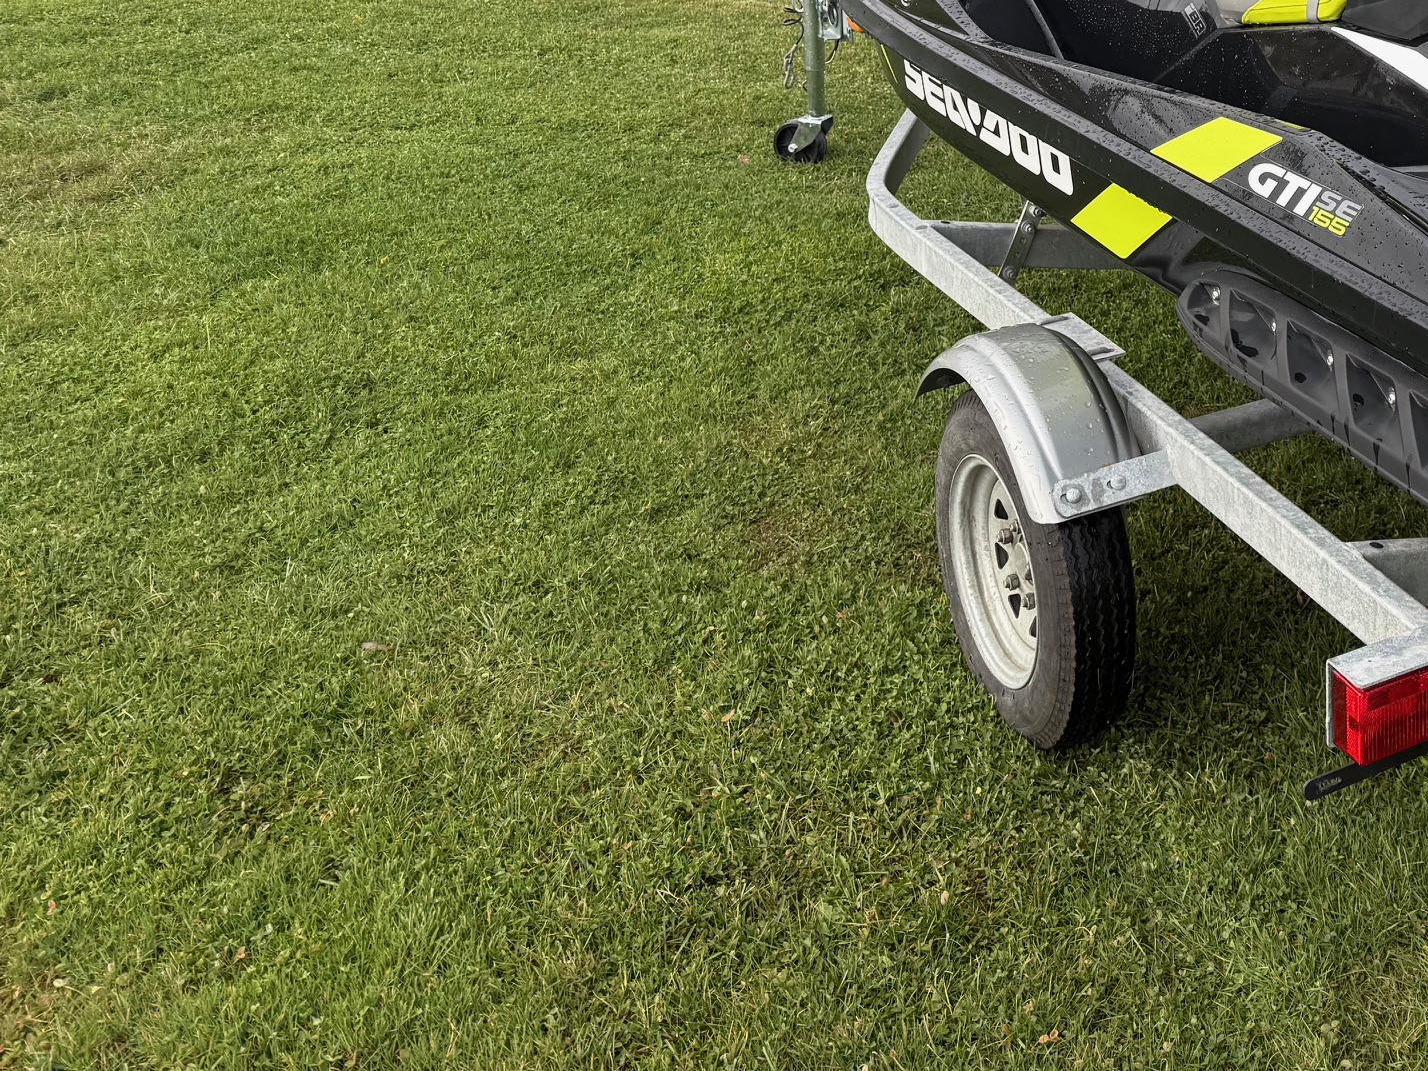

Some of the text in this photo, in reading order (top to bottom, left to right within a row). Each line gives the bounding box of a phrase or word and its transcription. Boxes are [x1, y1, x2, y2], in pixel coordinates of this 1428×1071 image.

[1248, 163, 1363, 222] GTI SE
[1308, 205, 1350, 236] 155
